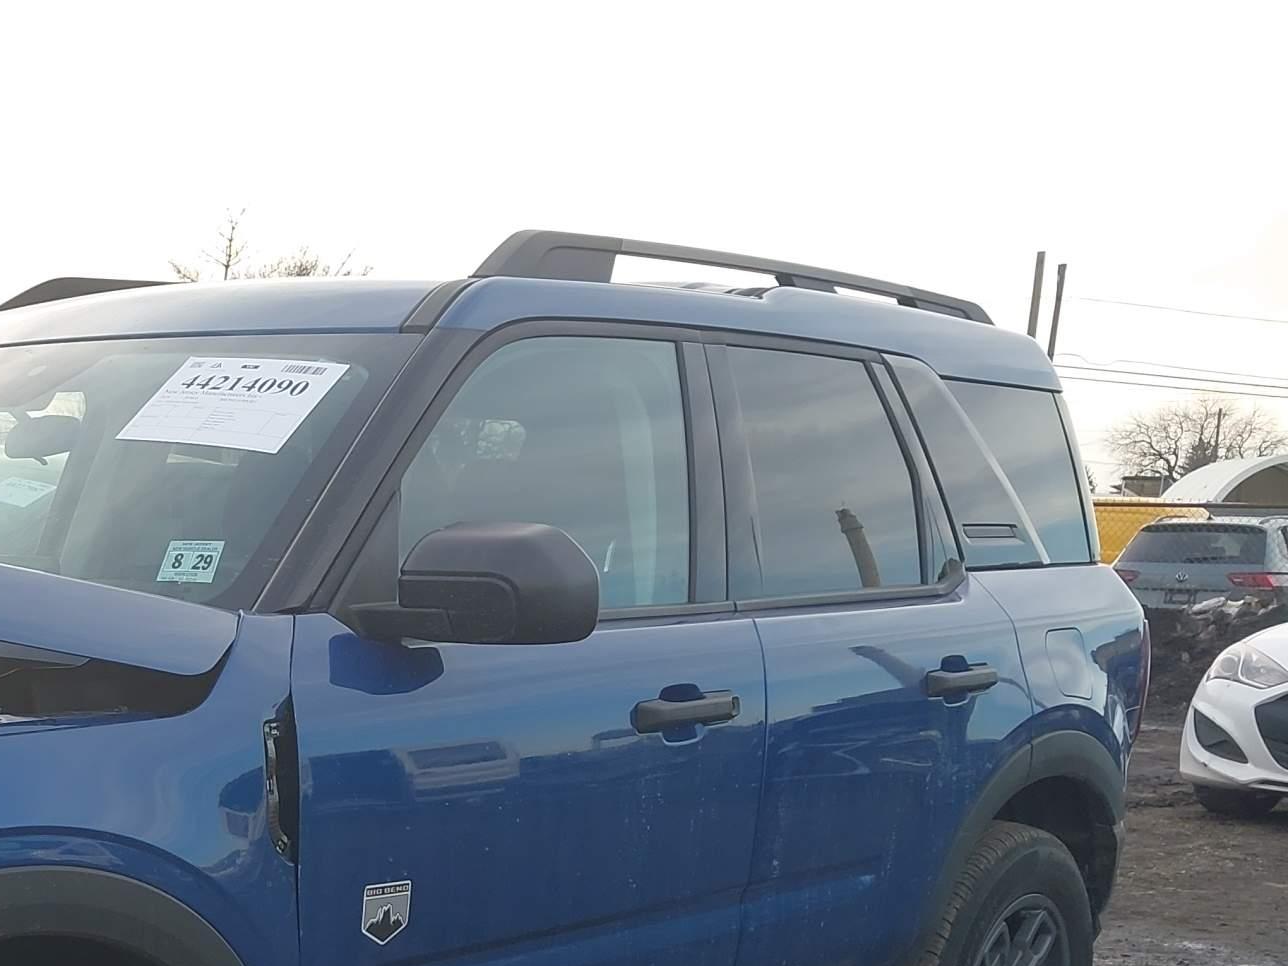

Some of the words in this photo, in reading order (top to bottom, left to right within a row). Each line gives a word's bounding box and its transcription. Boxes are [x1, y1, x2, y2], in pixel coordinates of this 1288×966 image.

[181, 374, 310, 397] 44214090
[171, 553, 184, 569] 8
[191, 553, 213, 570] 29
